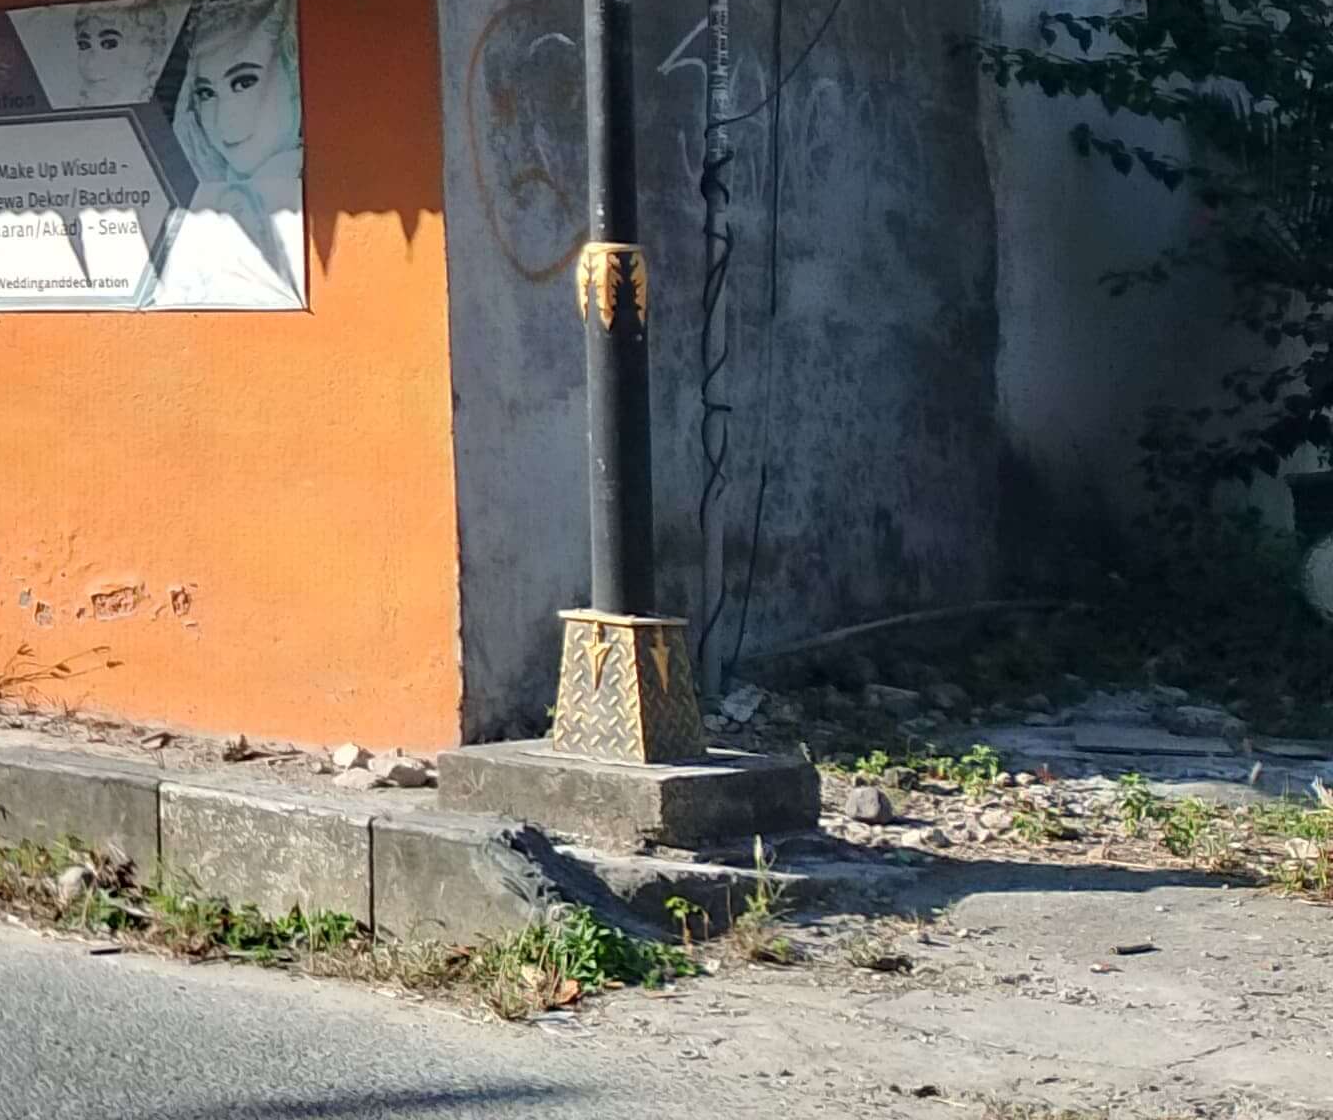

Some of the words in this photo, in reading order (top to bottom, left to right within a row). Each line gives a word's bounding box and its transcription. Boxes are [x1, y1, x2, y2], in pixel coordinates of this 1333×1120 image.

[38, 162, 58, 181] Up
[61, 157, 118, 176] Wisuda
[28, 186, 150, 208] Dekor/Backdrop
[99, 219, 140, 236] Sewa
